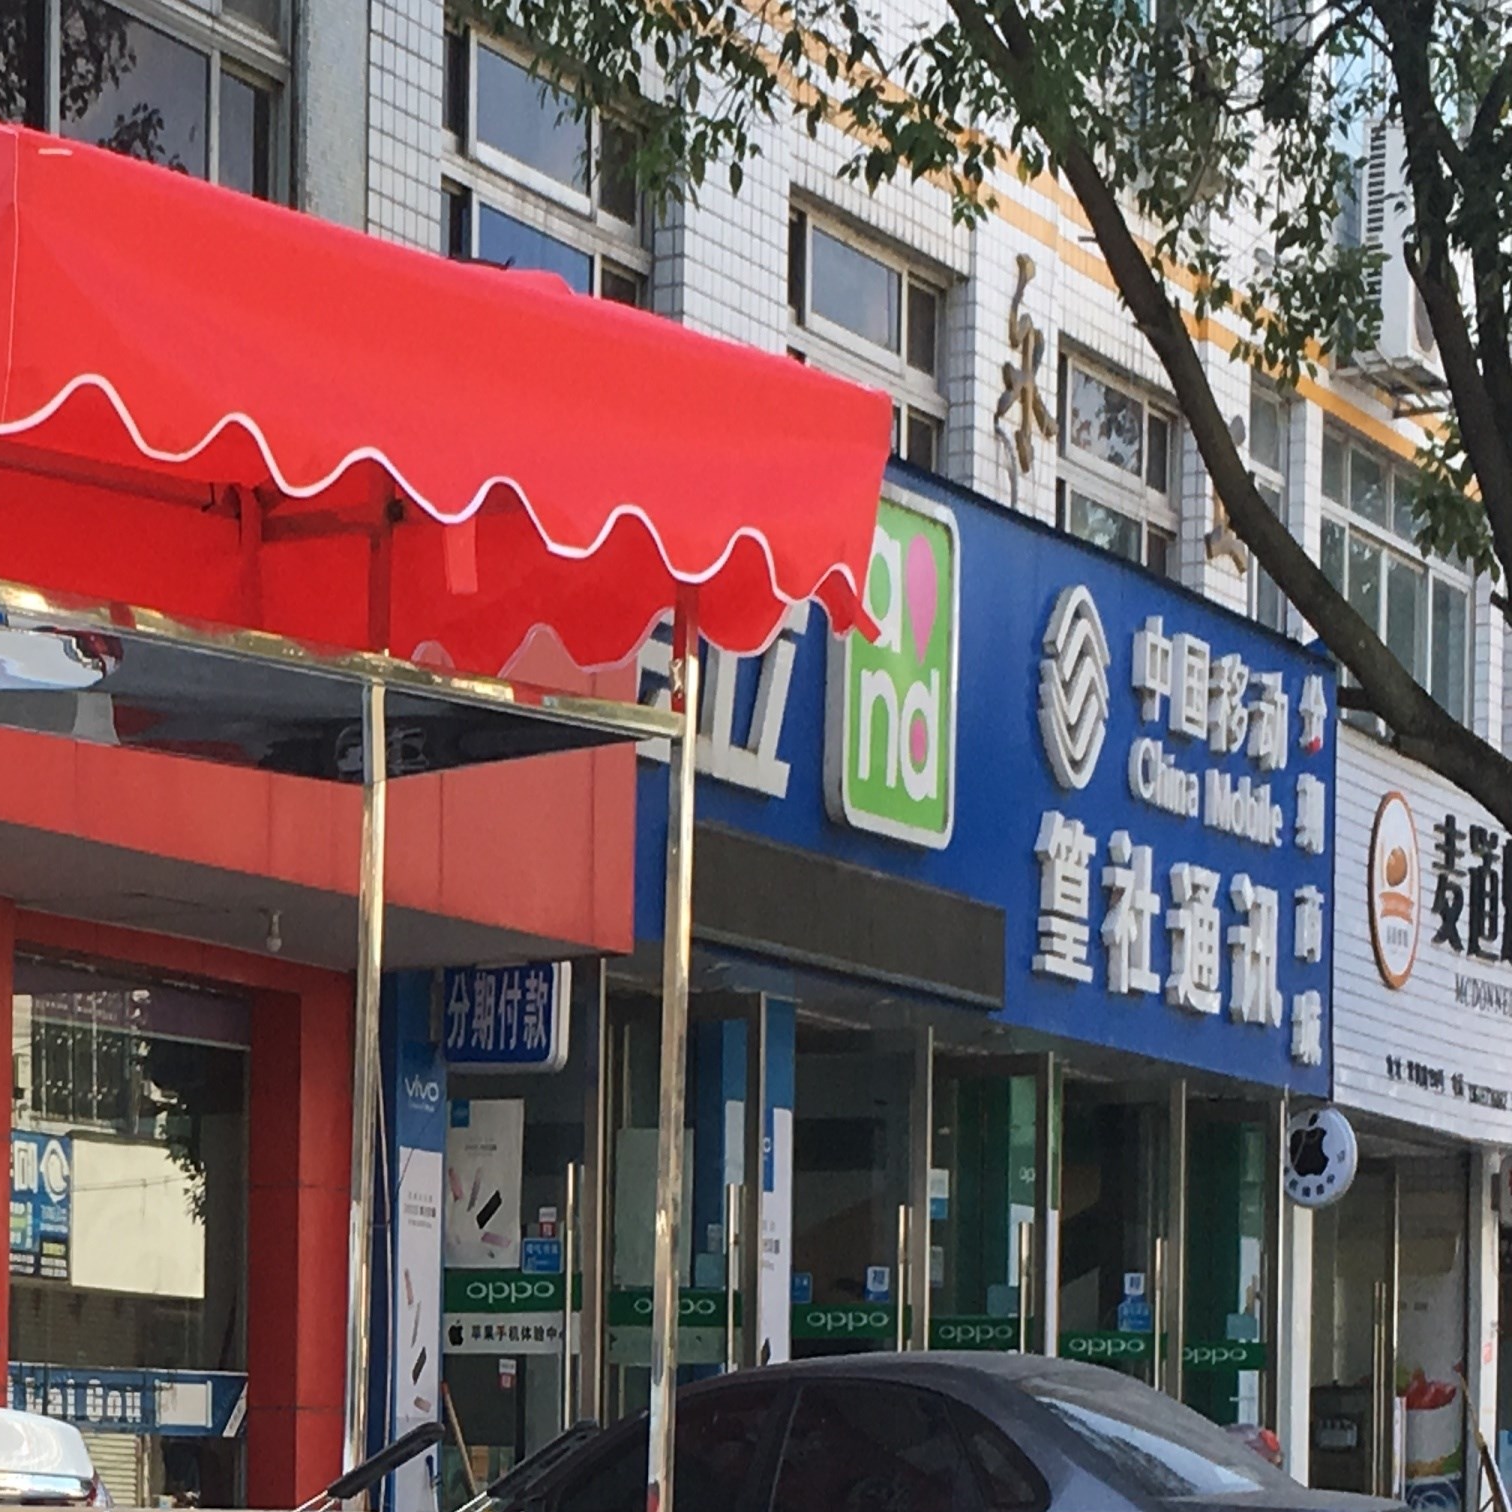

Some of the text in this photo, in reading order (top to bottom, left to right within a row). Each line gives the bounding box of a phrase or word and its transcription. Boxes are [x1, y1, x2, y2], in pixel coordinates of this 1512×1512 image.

[1132, 615, 1289, 771] 中国移动
[1128, 737, 1284, 849] China Mobile
[1431, 813, 1512, 966] 麦道
[1032, 810, 1284, 1030] 篁社通讯
[448, 969, 548, 1050] 分期付款
[404, 1073, 440, 1102] vivo
[465, 1281, 555, 1304] oppo
[806, 1311, 889, 1332] oppo
[939, 1325, 1013, 1343] oppo
[1069, 1338, 1146, 1356] oppo
